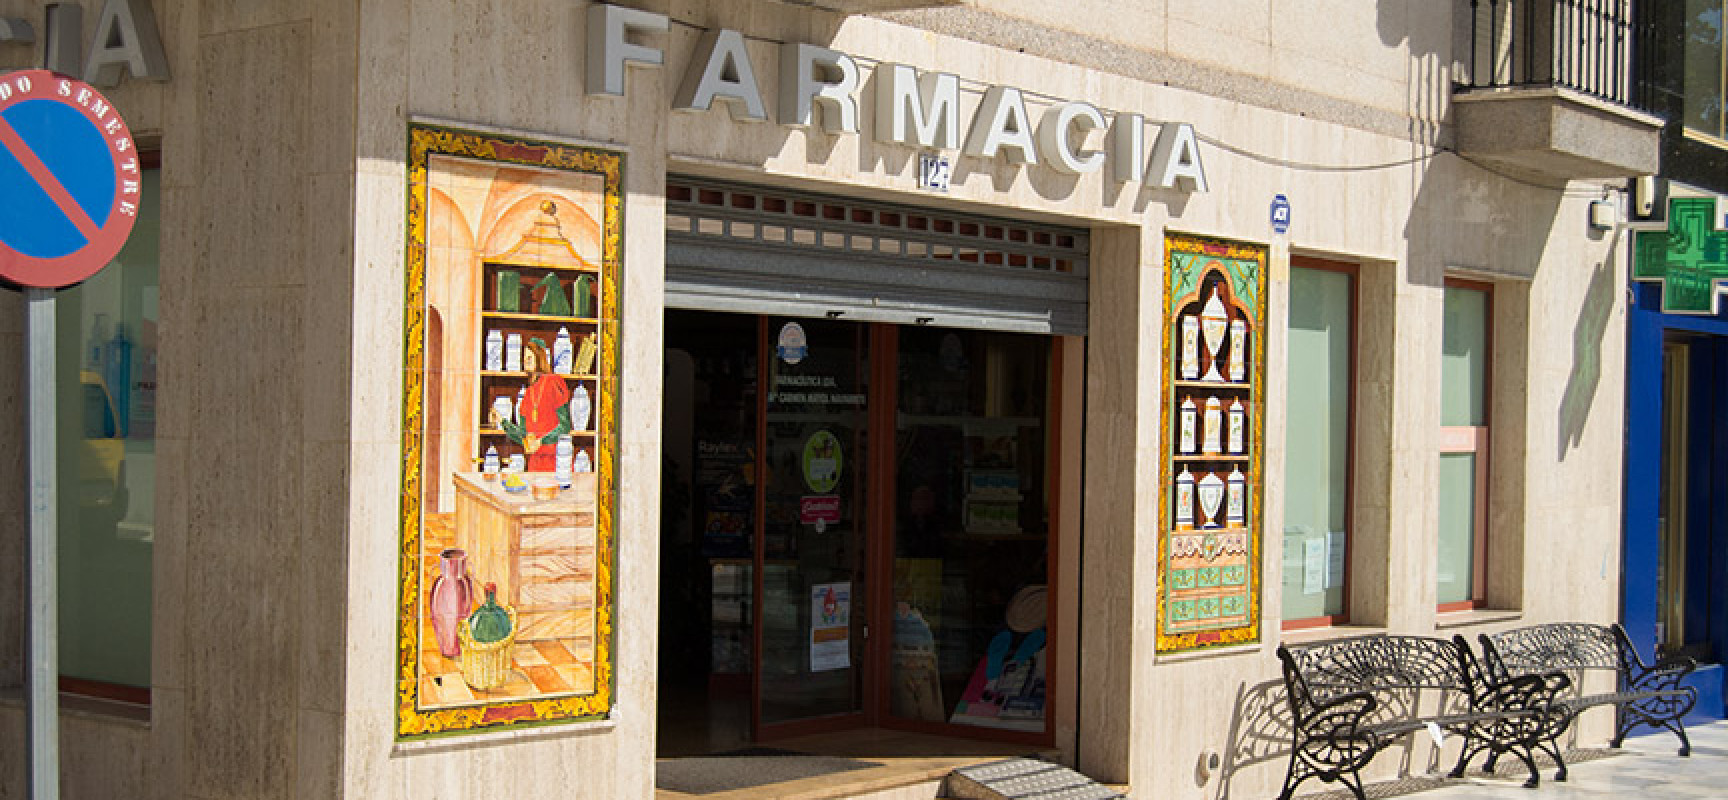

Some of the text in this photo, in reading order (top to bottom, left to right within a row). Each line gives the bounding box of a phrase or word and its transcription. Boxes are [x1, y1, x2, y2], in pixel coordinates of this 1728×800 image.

[58, 79, 139, 217] SEMESTRE
[587, 3, 1209, 193] FARMACIA
[922, 157, 949, 190] 127
